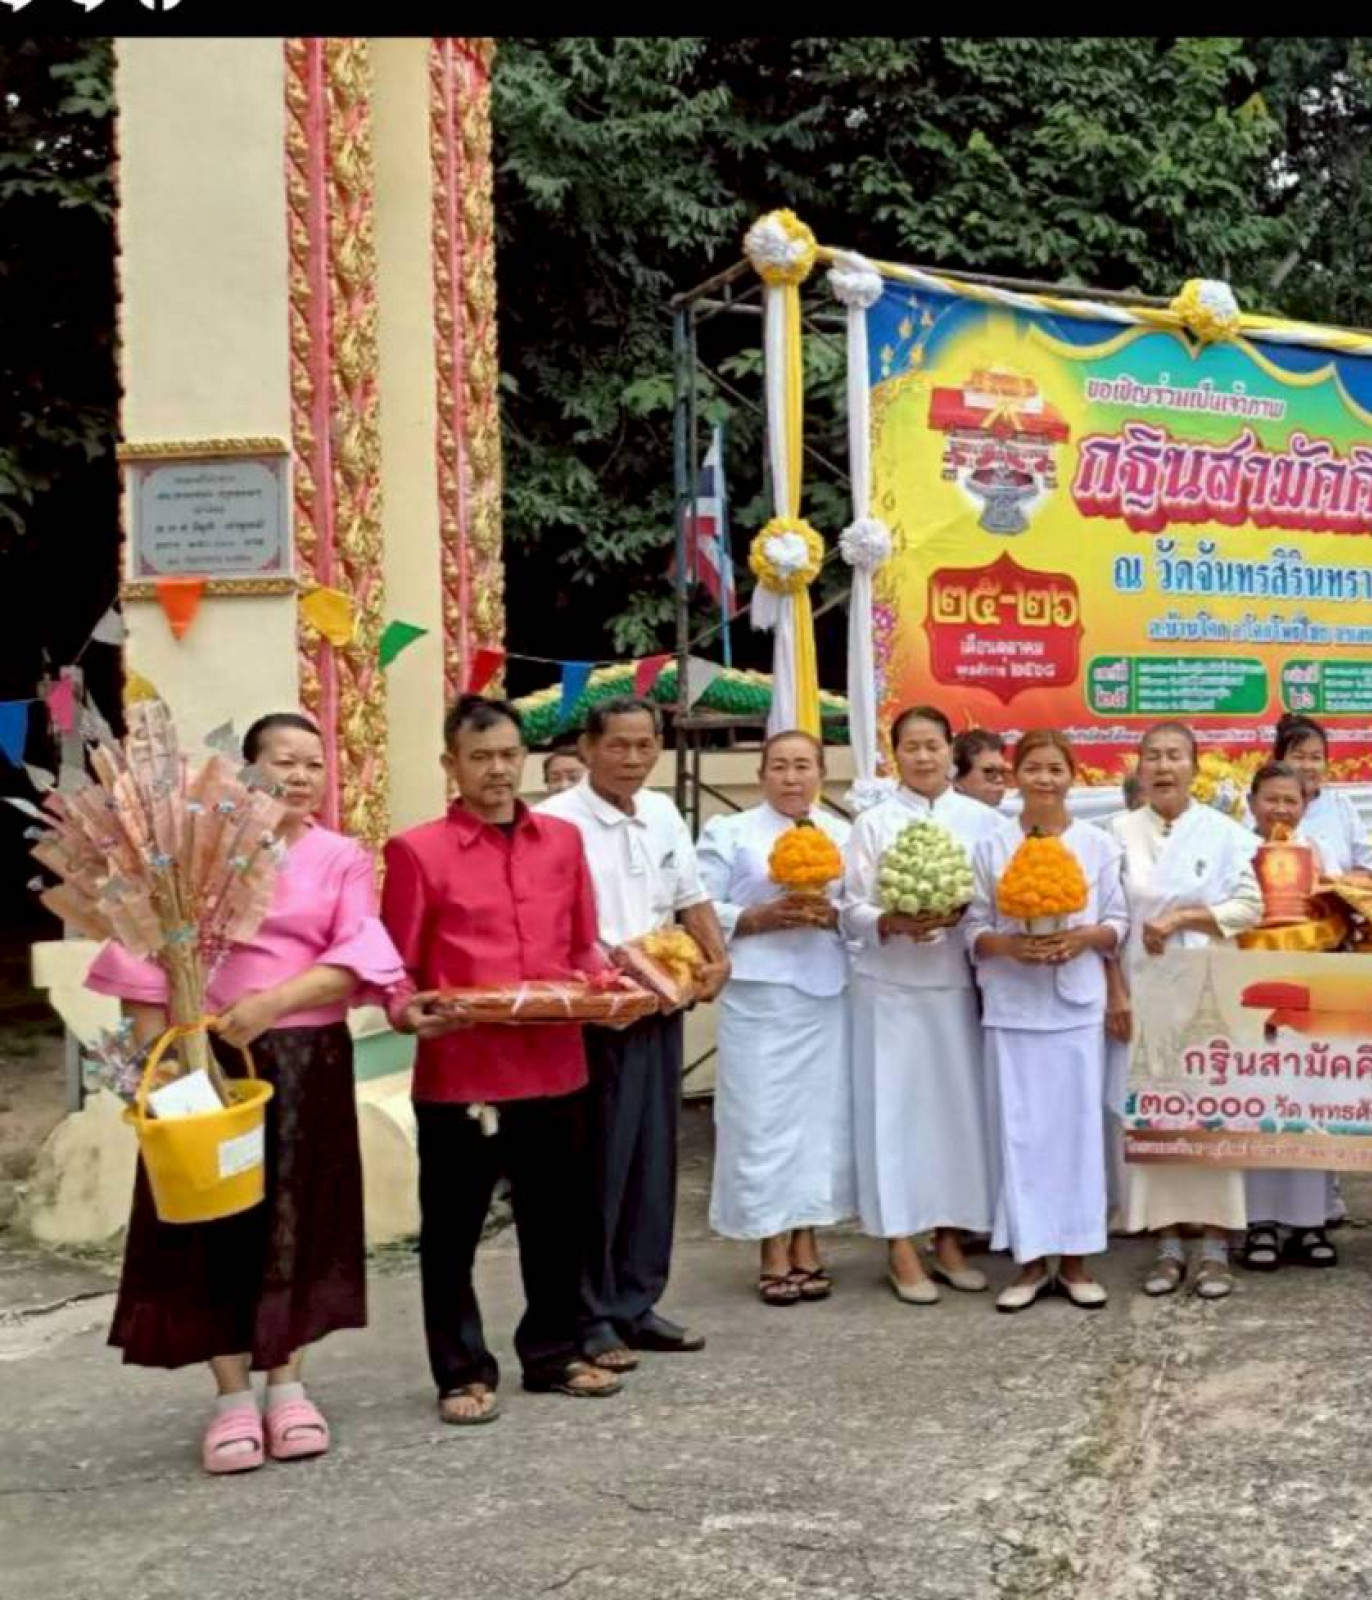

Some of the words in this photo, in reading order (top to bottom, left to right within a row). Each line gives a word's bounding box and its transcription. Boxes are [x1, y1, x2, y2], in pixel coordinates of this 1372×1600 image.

[1114, 556, 1143, 589] ณ
[932, 576, 1077, 627] ๒๕-๒๖
[1138, 1094, 1265, 1121] ๓๐,๐๐๐
[1275, 1096, 1301, 1119] วัด
